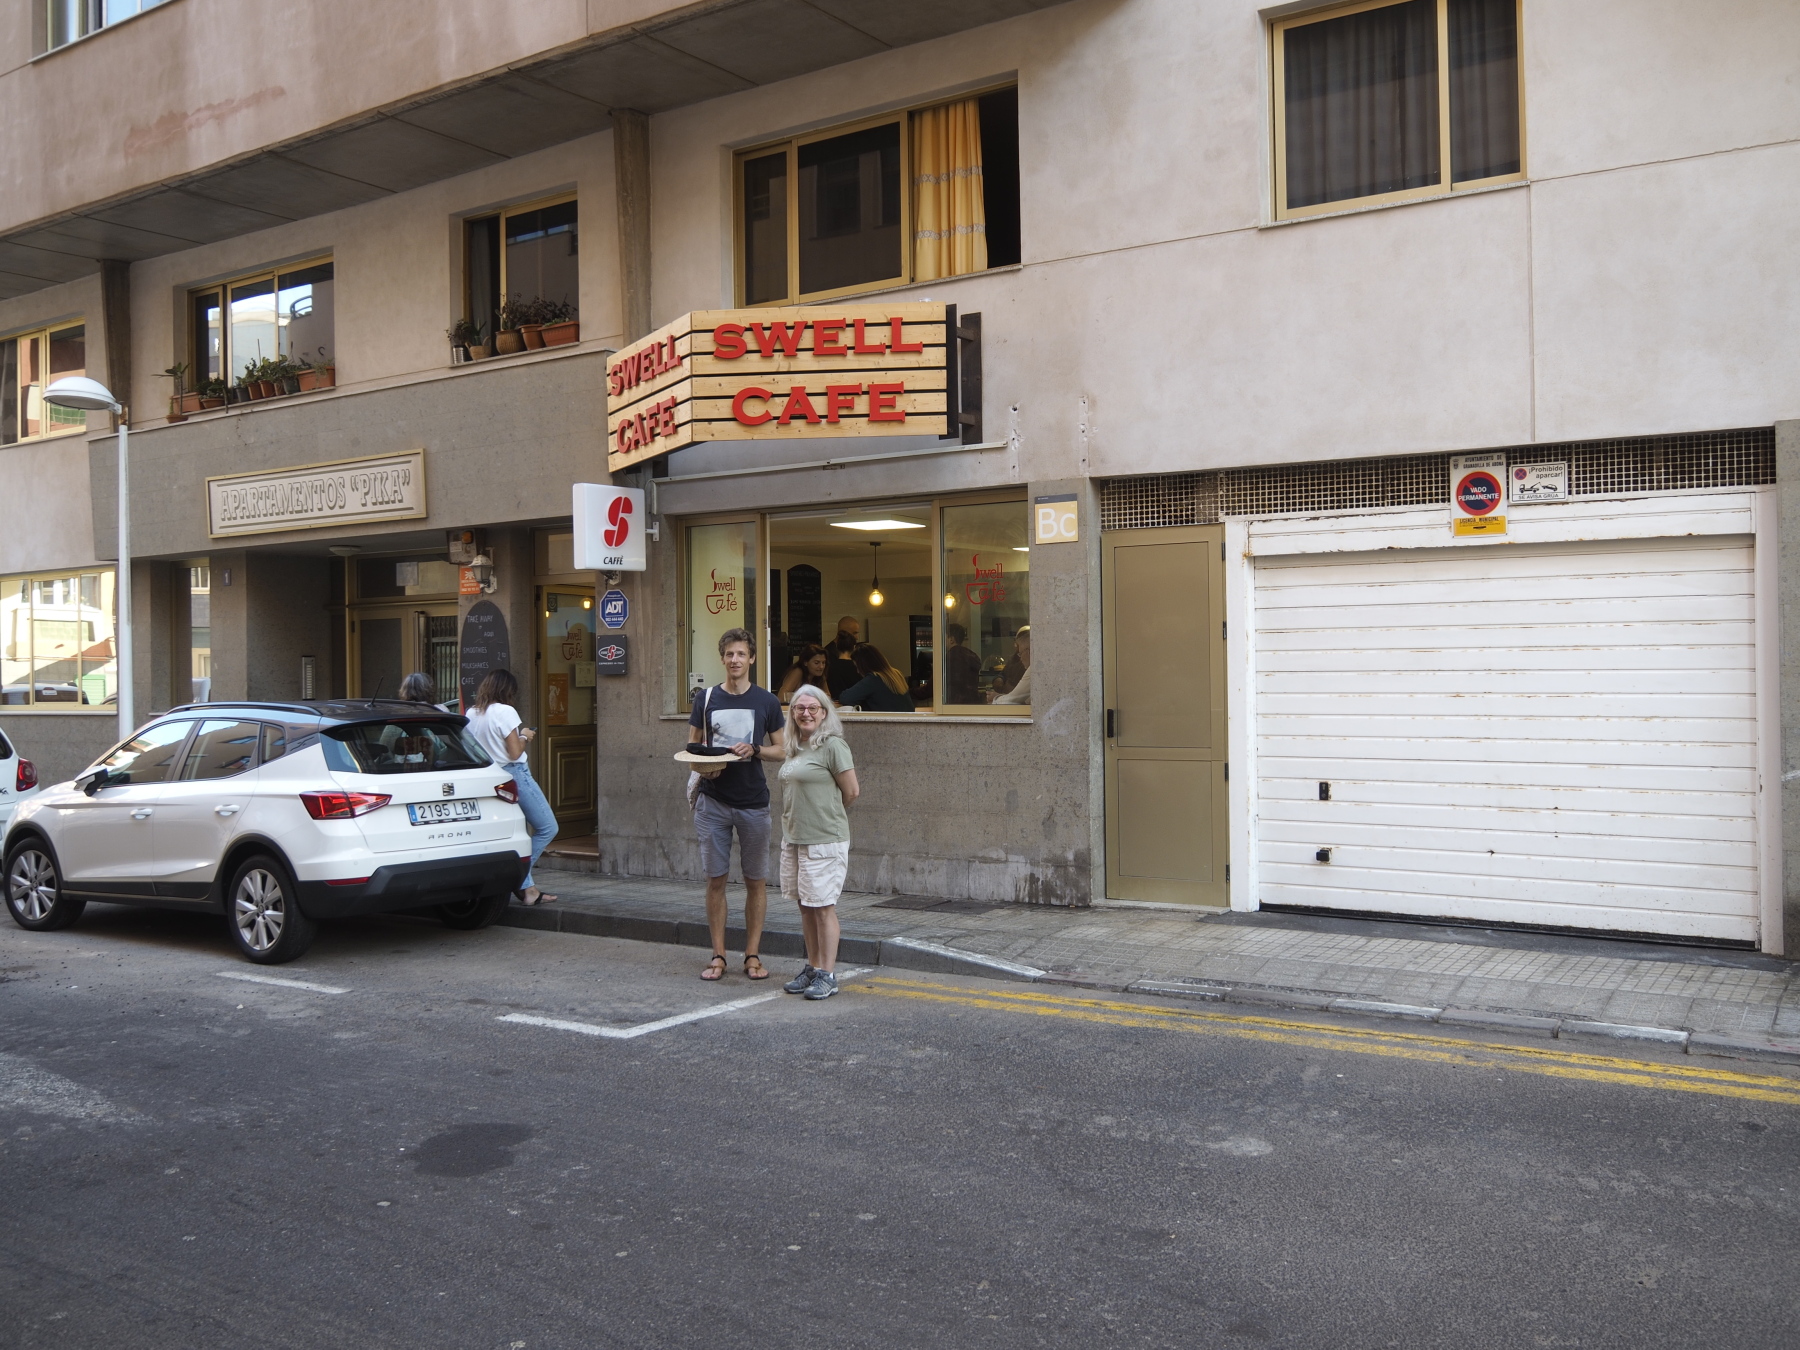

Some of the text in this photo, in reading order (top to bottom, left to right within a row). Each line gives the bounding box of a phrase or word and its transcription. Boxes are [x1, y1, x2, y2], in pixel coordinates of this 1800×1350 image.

[713, 317, 923, 359] SWELL
[610, 335, 682, 396] SWELL
[732, 381, 906, 426] CAFE
[616, 395, 677, 454] CAFE
[1464, 455, 1494, 463] AYUNTAMIENTO
[1529, 466, 1563, 474] ¡Prohibido
[1535, 471, 1563, 480] aparcar!
[220, 476, 346, 522] APARTAMENTOS
[1458, 493, 1500, 501] PERMANENTE
[1038, 508, 1076, 539] Bc
[603, 555, 624, 565] CAFFÈ
[972, 553, 1004, 581] Swell
[710, 568, 736, 593] Swell
[966, 581, 1006, 605] Café
[605, 601, 624, 614] ADT
[706, 593, 738, 615] Café
[467, 614, 493, 624] TAKE AWAY
[462, 646, 488, 654] SMOOTHIES
[418, 801, 478, 819] 2195 LBM
[428, 831, 472, 840] ARONA
